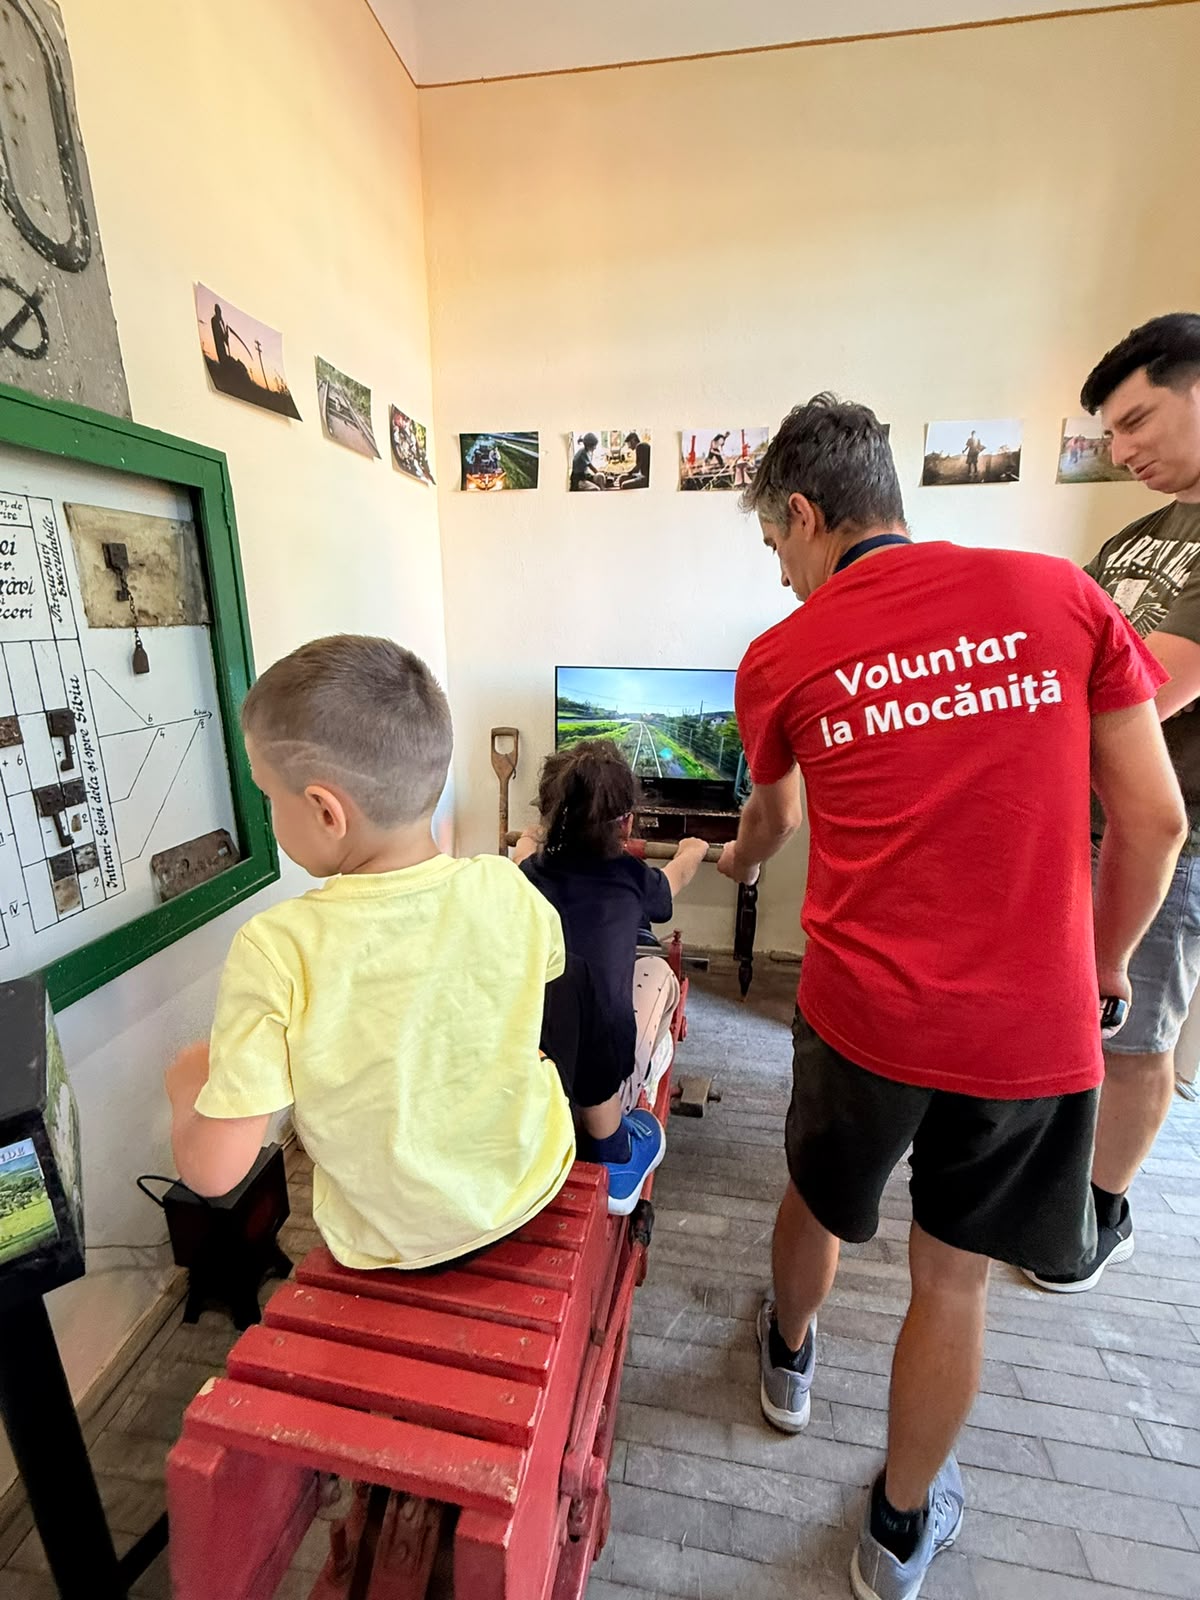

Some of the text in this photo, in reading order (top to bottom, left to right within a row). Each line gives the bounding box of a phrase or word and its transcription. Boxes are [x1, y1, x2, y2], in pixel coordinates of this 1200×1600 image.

[834, 631, 1028, 697] Voluntar
[68, 673, 88, 724] Sibiu
[819, 669, 1063, 748] la Mocăniță
[16, 753, 24, 767] 6
